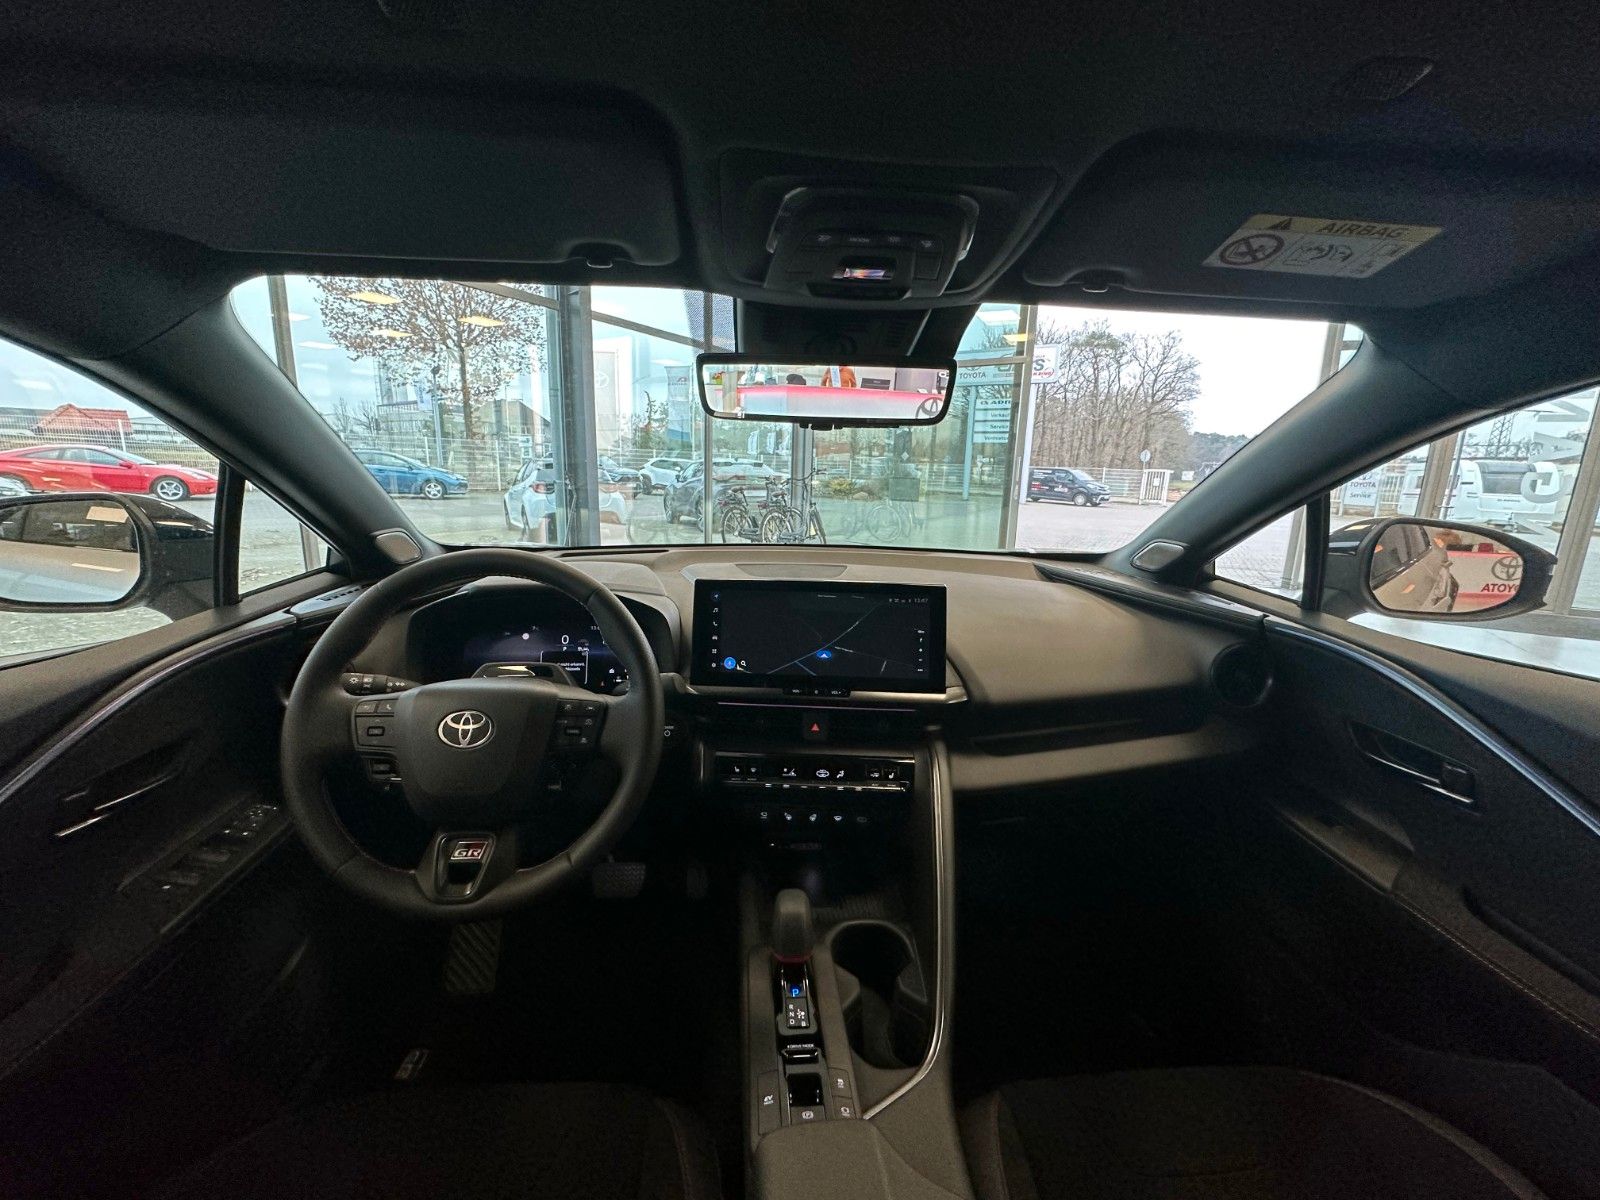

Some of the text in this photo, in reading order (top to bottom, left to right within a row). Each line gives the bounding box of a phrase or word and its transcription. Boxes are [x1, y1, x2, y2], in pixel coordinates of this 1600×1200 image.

[1318, 222, 1409, 239] AIRBAG
[959, 371, 986, 379] TOYOTA
[561, 634, 570, 645] 0
[453, 848, 481, 857] GR
[792, 988, 799, 997] P
